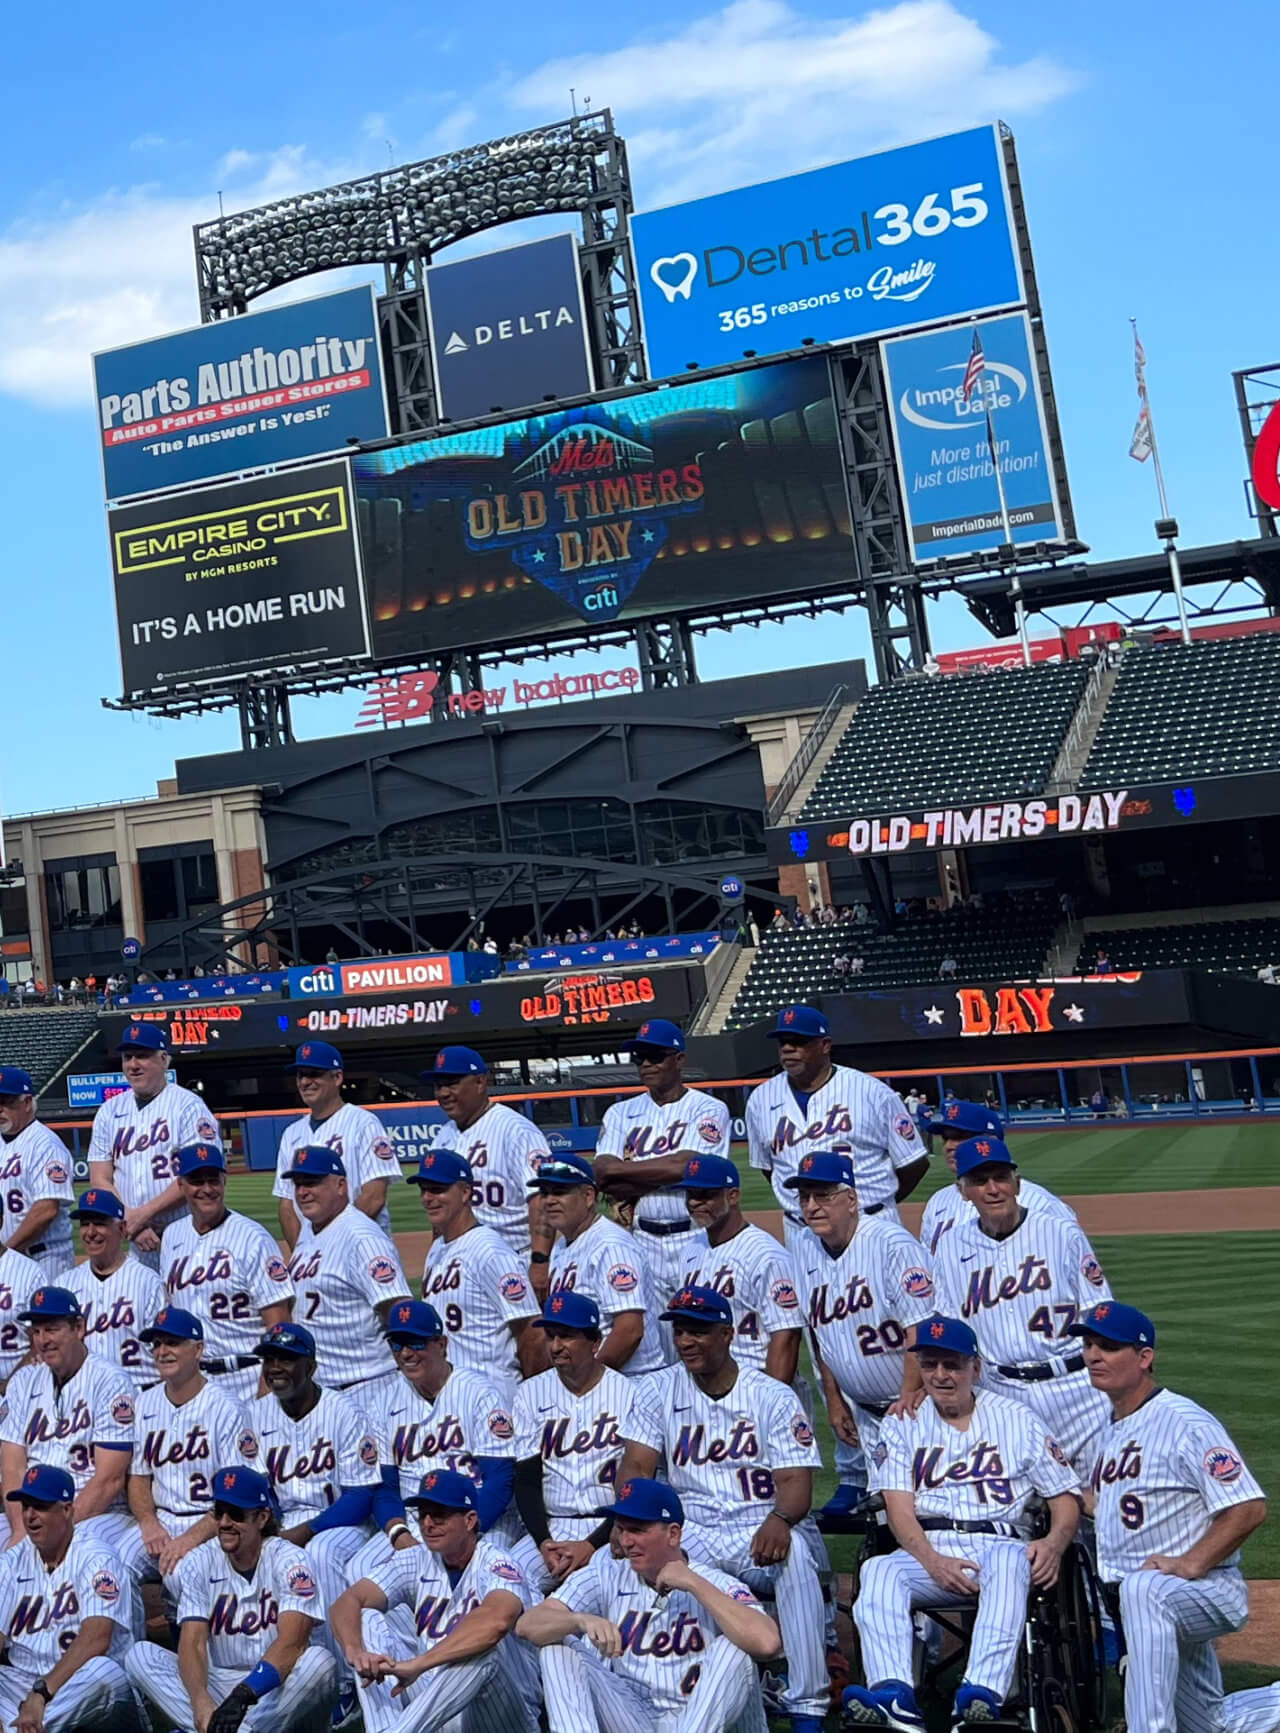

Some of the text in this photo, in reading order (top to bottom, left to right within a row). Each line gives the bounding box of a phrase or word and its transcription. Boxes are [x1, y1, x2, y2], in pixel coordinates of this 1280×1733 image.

[719, 257, 936, 332] 365 reasons to Smile
[475, 306, 575, 346] DELTA
[101, 336, 368, 430] Parts Authority
[954, 389, 1012, 418] Dade
[111, 374, 363, 442] Auto Parts Super Stores
[186, 423, 257, 448] Answer
[260, 416, 278, 432] Is
[931, 436, 1010, 466] More than
[550, 439, 617, 476] Mets
[913, 448, 1038, 492] just distribution!
[467, 463, 705, 540] OLD TIMERS
[127, 502, 329, 559] EMPIRE CITY
[931, 510, 1035, 538] ImperialDad.com
[192, 538, 267, 562] CASINO
[558, 522, 633, 572] DAY
[185, 555, 278, 582] BY MGM RESORTS
[131, 586, 346, 645] IT'S A HOME RUN
[583, 588, 618, 611] citi
[448, 665, 641, 714] new balance
[847, 791, 1128, 855] OLD TIMERS DAY
[721, 882, 739, 893] citi
[300, 963, 444, 993] citi PAVILION
[308, 999, 449, 1031] OLD TIMERS DAY
[521, 996, 561, 1022] OLD
[565, 977, 656, 1015] TIMERS
[955, 988, 1056, 1037] DAY
[170, 1020, 210, 1045] DAY
[70, 1075, 114, 1086] BULLPEN
[71, 1091, 97, 1101] NOW
[770, 1103, 854, 1158] Mets
[166, 1249, 234, 1296] Mets
[960, 1255, 1053, 1320] Mets
[209, 1292, 251, 1321] 22
[808, 1274, 875, 1330] Mets
[1027, 1302, 1080, 1340] 47
[856, 1319, 907, 1357] 20
[24, 1399, 93, 1445] Mets
[393, 1415, 464, 1463] Mets
[673, 1419, 759, 1467] Mets
[143, 1425, 210, 1467] Mets
[735, 1467, 775, 1501] 18
[1120, 1494, 1144, 1531] 9
[617, 1610, 706, 1658] Mets
